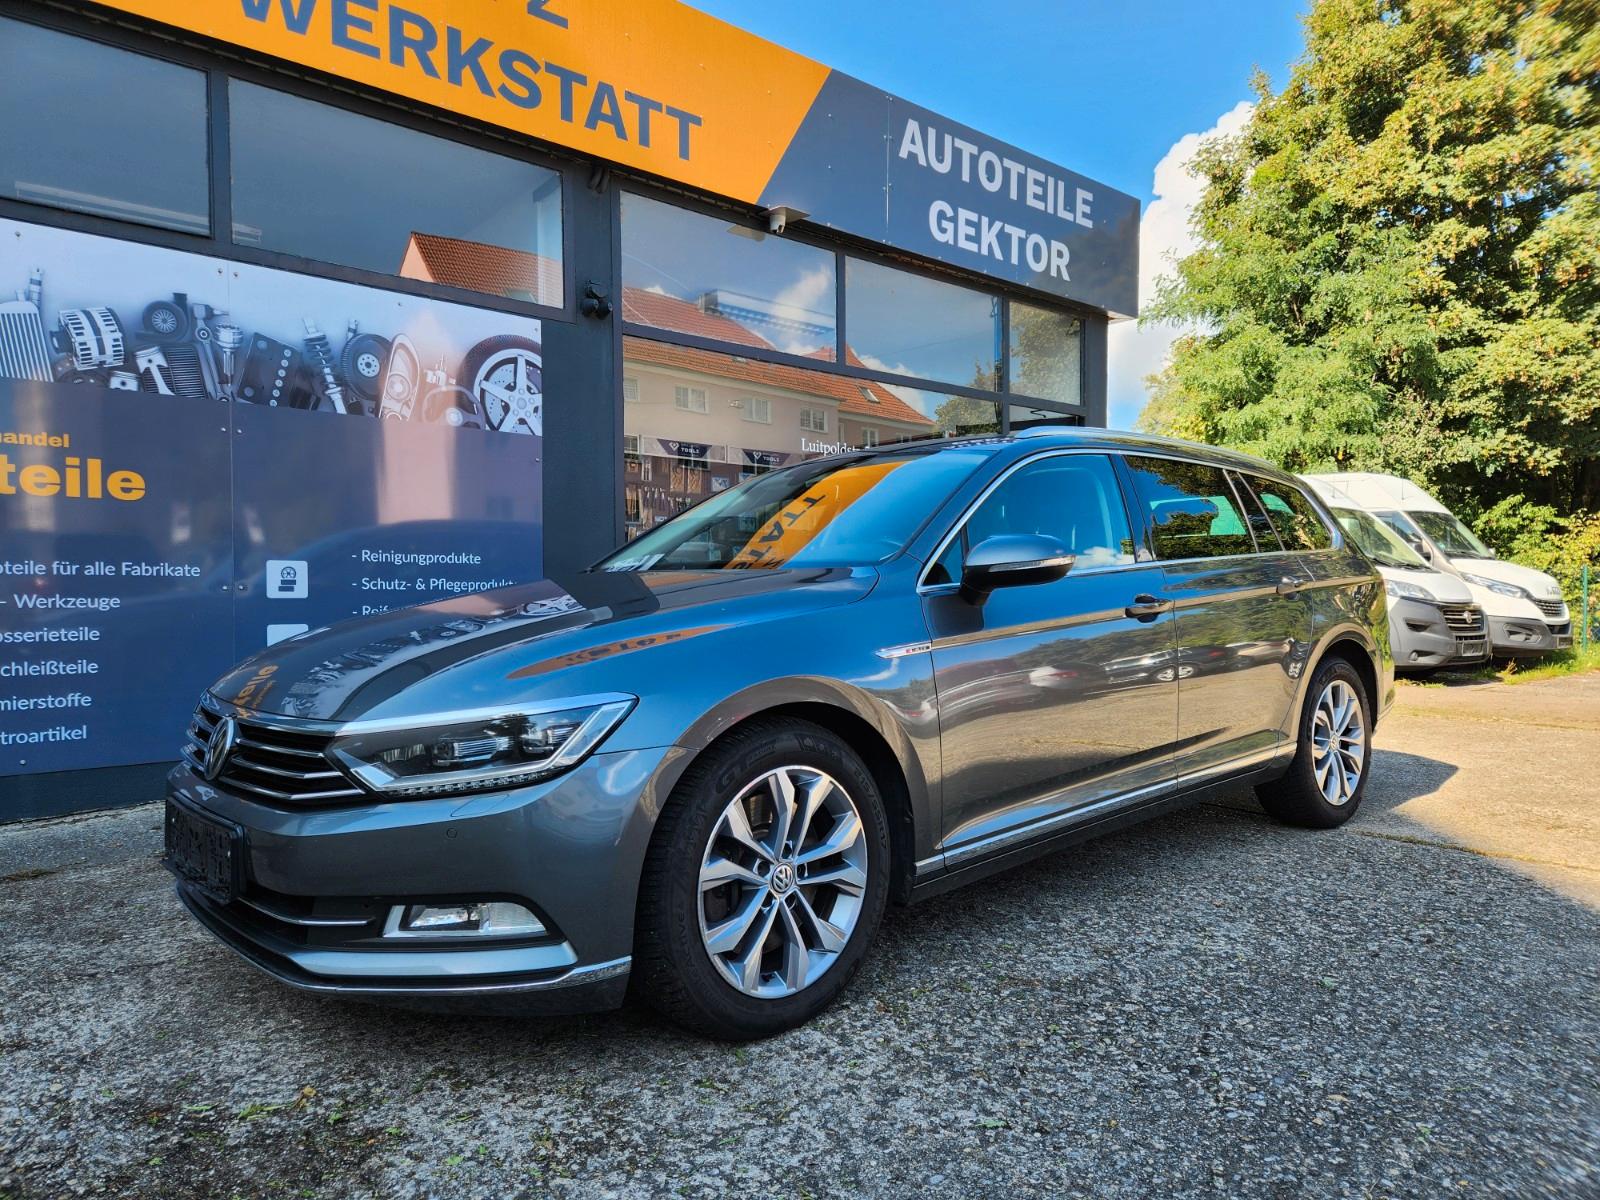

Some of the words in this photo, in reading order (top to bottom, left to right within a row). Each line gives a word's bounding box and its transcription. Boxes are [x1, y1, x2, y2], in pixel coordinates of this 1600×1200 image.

[899, 118, 1094, 229] AUTOTEILE
[928, 200, 1071, 282] GEKTOR
[0, 432, 70, 448] andel
[361, 550, 482, 566] Reinigungprodukte
[0, 560, 47, 575] teile
[52, 561, 80, 576] für
[84, 562, 116, 576] alle
[121, 562, 201, 577] Fabrikate
[361, 577, 412, 591] Schutz-
[415, 578, 426, 591] &
[13, 593, 121, 611] Werkzeuge
[0, 627, 100, 643] sserieteile
[0, 660, 99, 677] chleißteile
[0, 725, 88, 745] troartikel
